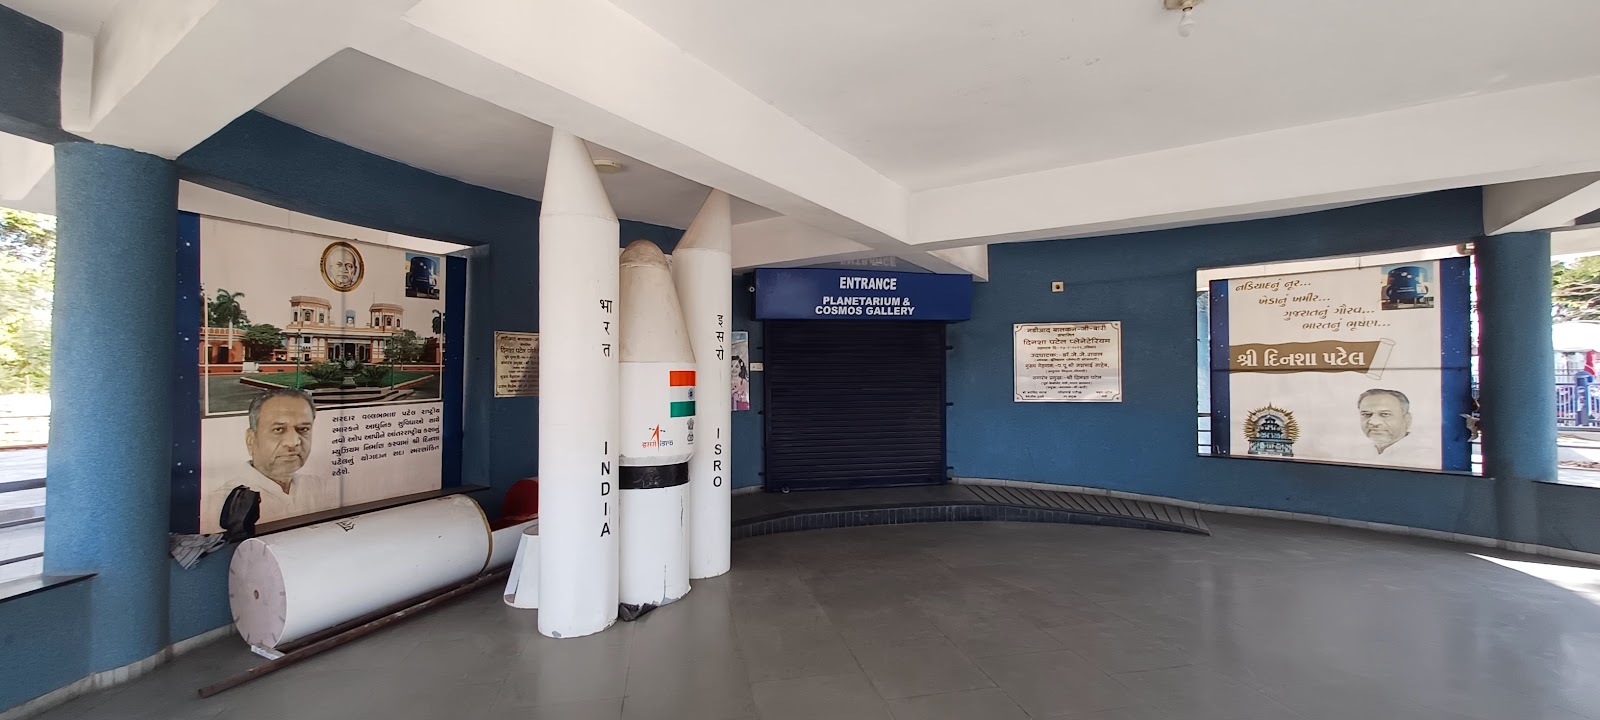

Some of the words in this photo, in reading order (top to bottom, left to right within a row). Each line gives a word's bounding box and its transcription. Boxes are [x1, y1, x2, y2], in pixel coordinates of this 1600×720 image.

[839, 276, 897, 290] ENTRANCE
[1235, 278, 1282, 293] નડિયાદનું
[822, 296, 901, 306] PLANETARIUM
[902, 298, 911, 306] &
[1258, 293, 1289, 307] ખેડાનું
[815, 305, 863, 315] COSMOS
[865, 306, 915, 316] GALLERY
[1283, 305, 1330, 321] ગુજરાતનું
[600, 299, 613, 357] भारत
[1302, 318, 1342, 332] ભારતનું
[715, 314, 725, 361] इसरो
[1023, 338, 1047, 346] दिनशा
[1049, 337, 1067, 345] पटेल
[1236, 349, 1258, 368] શ્રી
[1264, 348, 1318, 366] દિનશા
[1323, 347, 1366, 366] પટેલ
[332, 415, 356, 423] સરદાર
[712, 427, 723, 487] ISRO
[600, 441, 611, 537] INDIA
